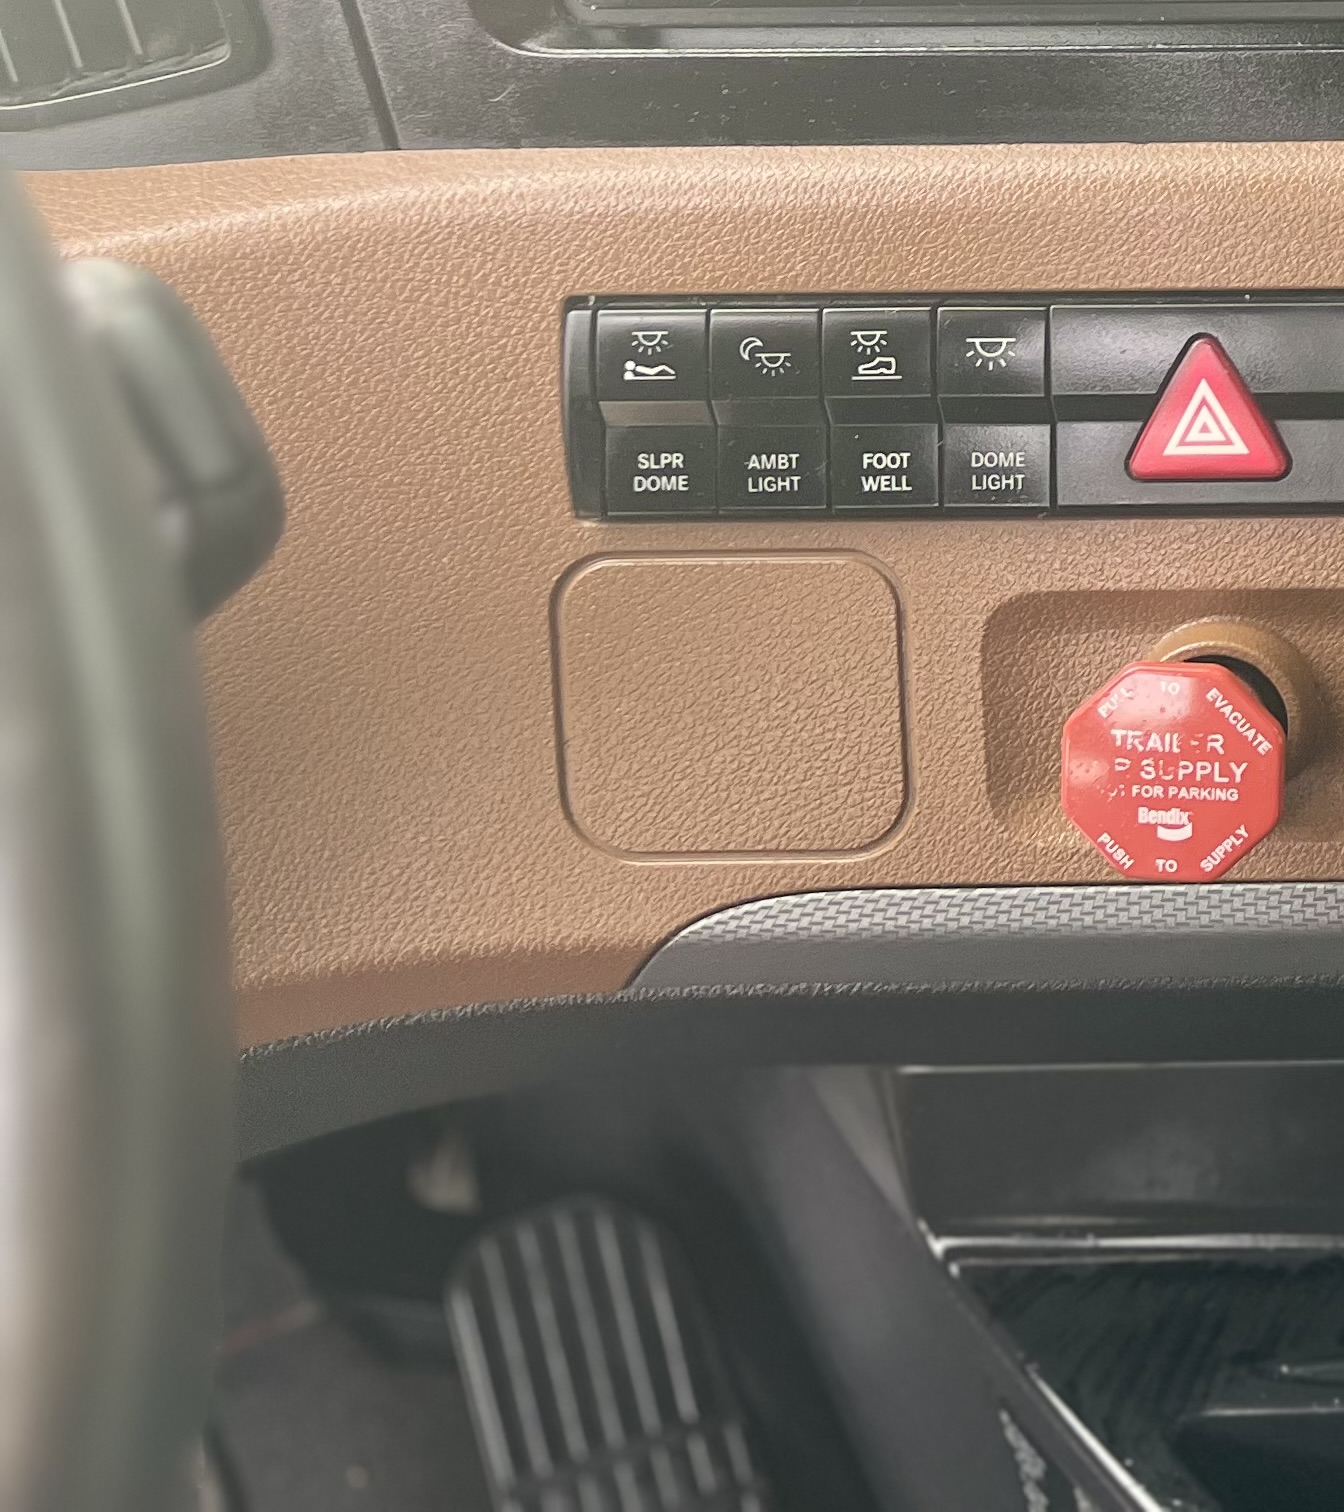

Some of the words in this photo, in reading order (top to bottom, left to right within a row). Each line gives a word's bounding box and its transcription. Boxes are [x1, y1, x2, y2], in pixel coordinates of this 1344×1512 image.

[637, 452, 684, 470] SLPR
[750, 453, 800, 470] AMBT
[862, 452, 911, 469] FOOT
[971, 451, 1026, 468] DOME
[633, 475, 689, 492] DOME
[747, 475, 802, 493] LIGHT
[860, 475, 913, 492] WELL
[971, 473, 1026, 491] LIGHT
[1205, 687, 1273, 756] EVACUATE
[1131, 784, 1165, 799] FOR
[1168, 785, 1239, 802] PARKING
[1136, 805, 1191, 825] Bendix
[1097, 832, 1135, 870] PUSH
[1155, 858, 1178, 873] TO
[1199, 824, 1249, 872] SUPPLY
